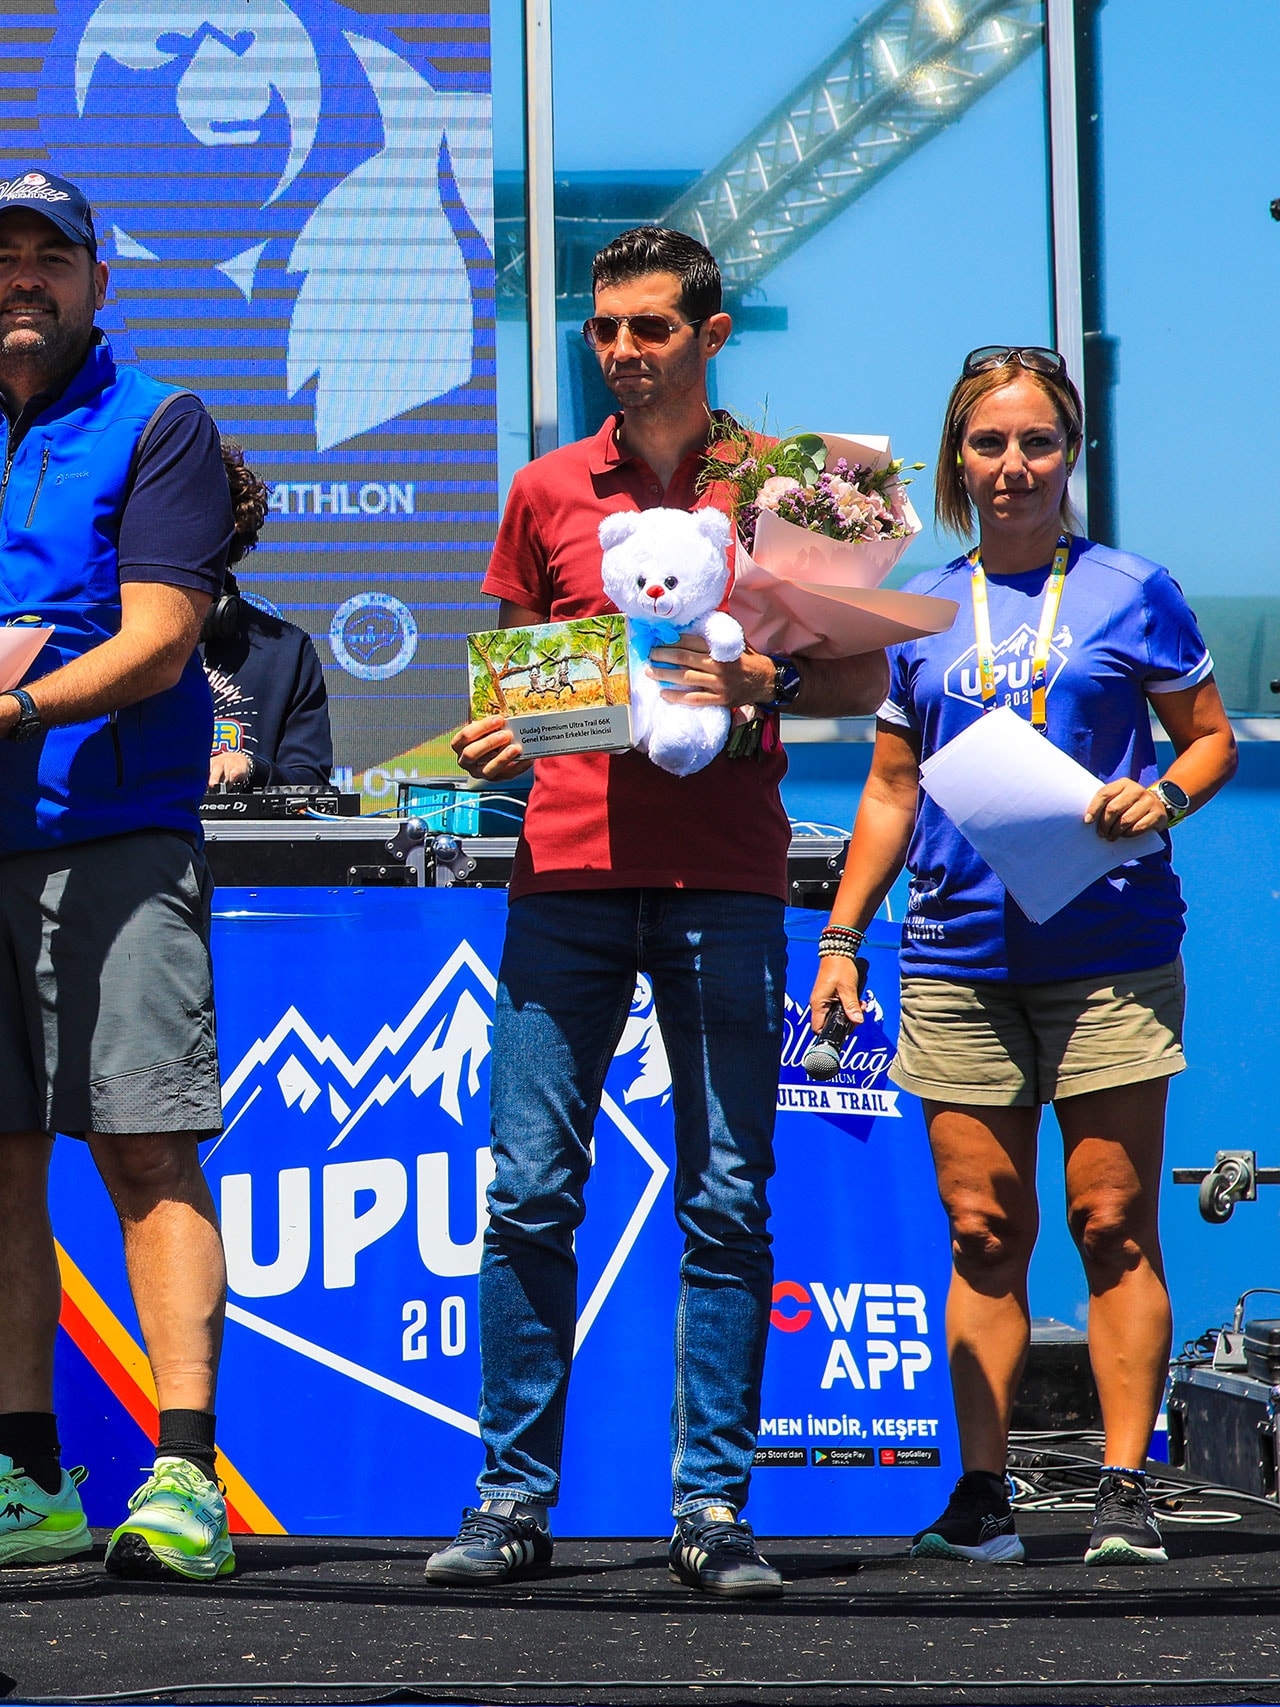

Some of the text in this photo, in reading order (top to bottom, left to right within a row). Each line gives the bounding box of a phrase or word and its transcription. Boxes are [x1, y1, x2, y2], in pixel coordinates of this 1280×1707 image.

[267, 482, 416, 514] ATHLON
[961, 659, 1033, 697] UPU
[519, 718, 611, 735] Uludağ Premium Ultra Trail 66K
[521, 736, 539, 744] Genel
[565, 730, 590, 739] Erkekler
[777, 1088, 889, 1112] ULTRA TRAIL
[220, 1147, 495, 1298] UPU
[770, 1280, 929, 1334] OWER
[402, 1296, 466, 1361] 20
[820, 1339, 932, 1390] APP
[757, 1414, 939, 1441] MEN İNDİR, KEŞFET
[830, 1451, 866, 1460] Google Play
[896, 1450, 932, 1460] AppGallery
